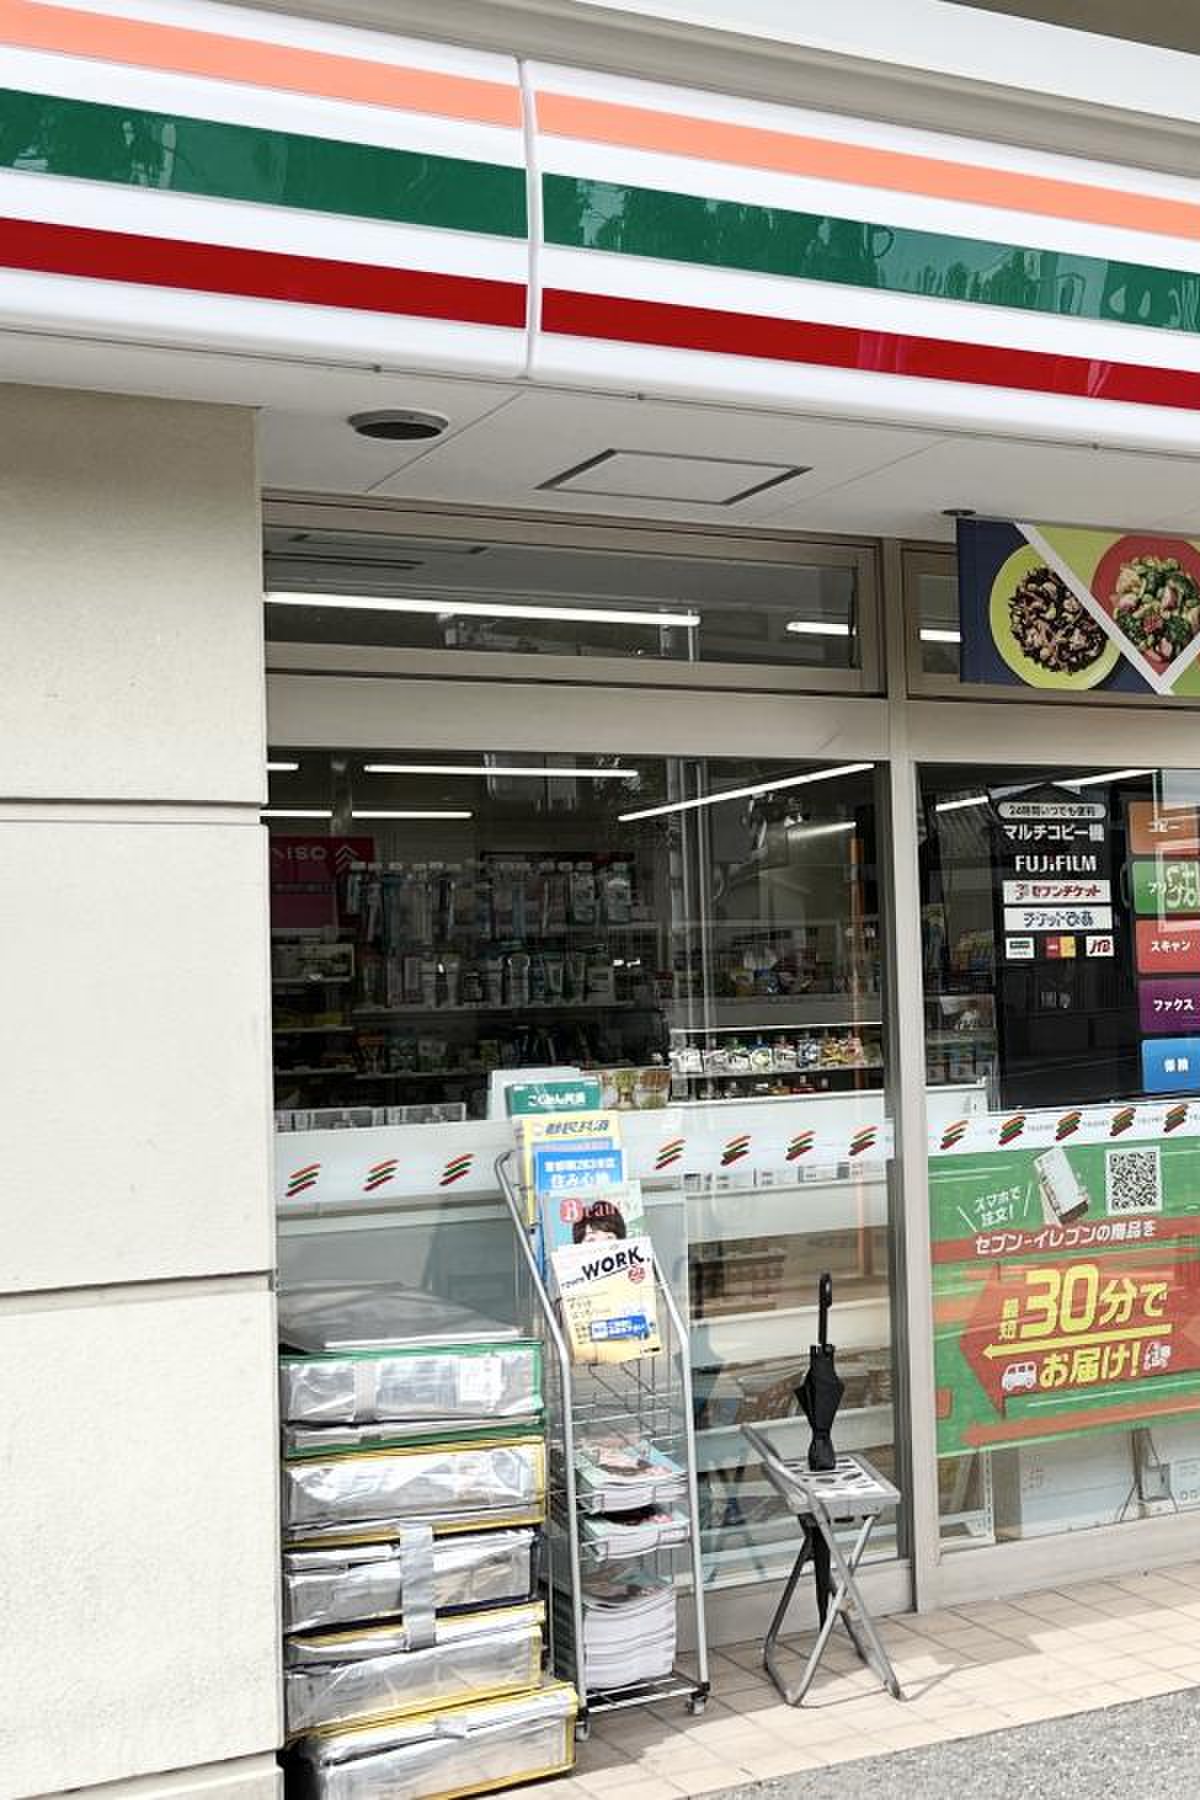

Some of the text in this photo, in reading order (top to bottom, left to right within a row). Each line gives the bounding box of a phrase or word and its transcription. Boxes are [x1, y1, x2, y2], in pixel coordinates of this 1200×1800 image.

[1015, 855, 1097, 872] FUJIFILM
[1151, 940, 1191, 952] スキャン
[1153, 998, 1195, 1012] ファクス
